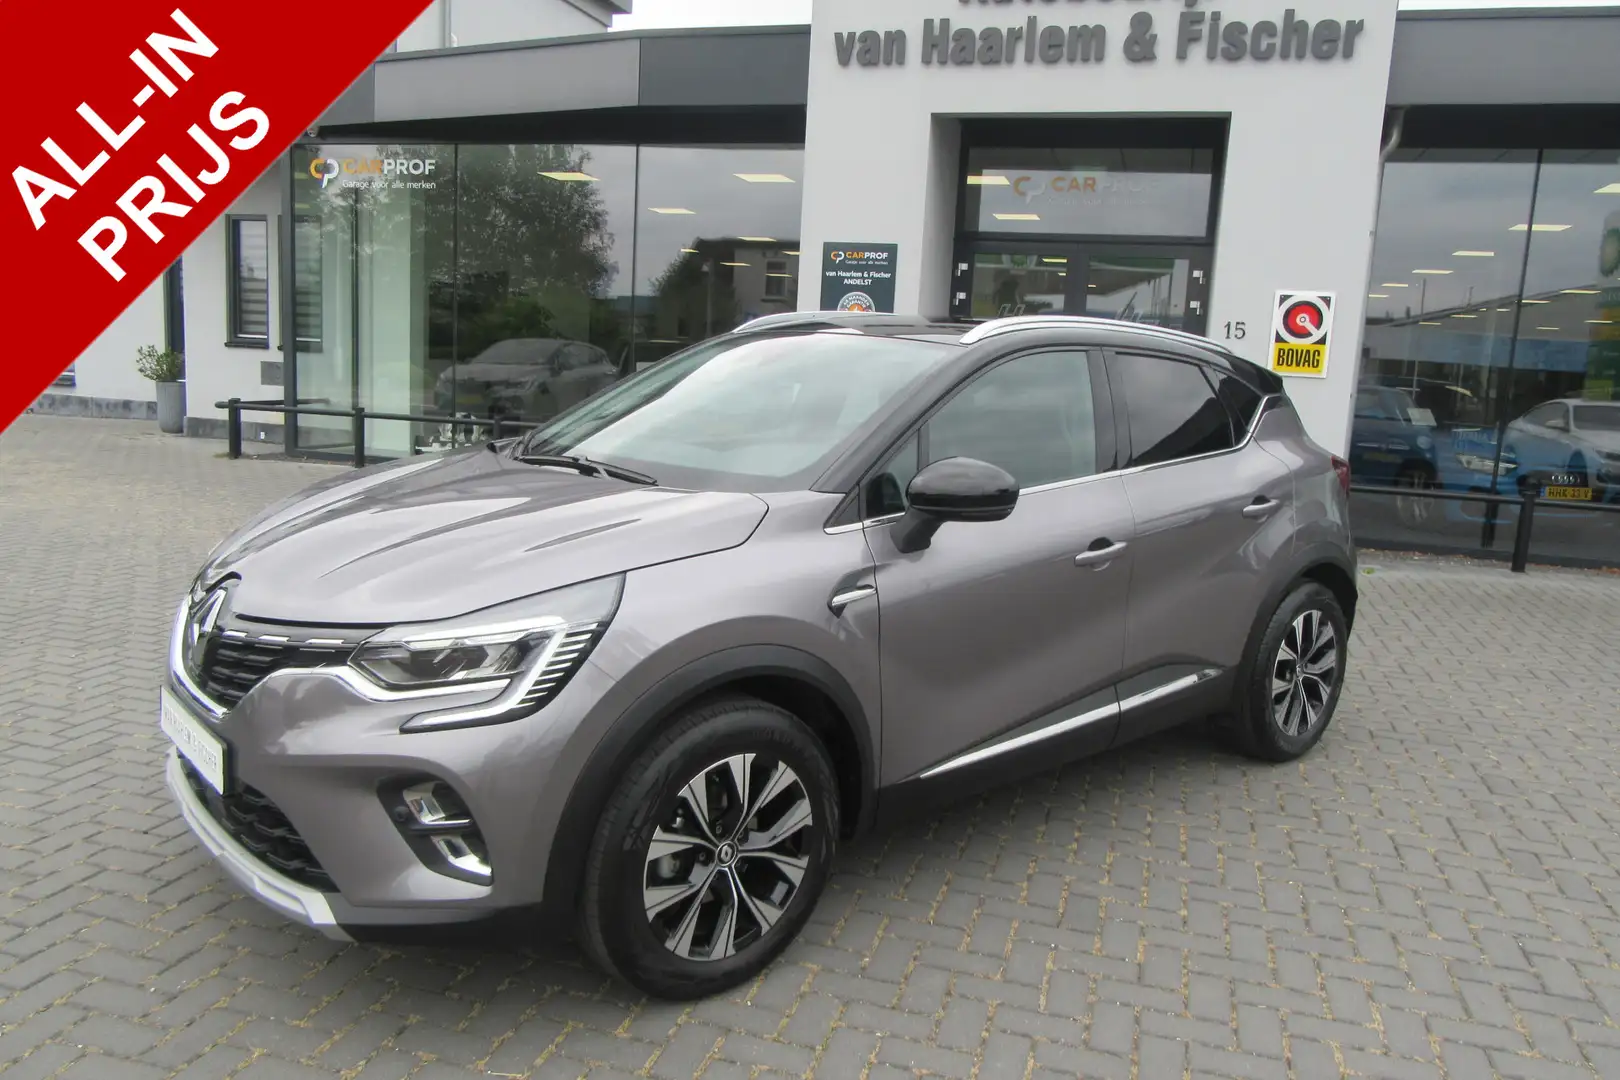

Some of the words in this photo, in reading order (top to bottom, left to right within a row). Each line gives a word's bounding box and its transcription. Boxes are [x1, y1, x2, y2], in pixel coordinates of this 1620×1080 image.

[834, 29, 907, 67] van
[921, 16, 1106, 65] Haarlem
[1123, 11, 1158, 62] &
[1176, 9, 1364, 60] Fischer
[343, 158, 436, 175] CARPROF
[342, 180, 369, 190] Garage
[391, 180, 404, 189] alle
[407, 180, 436, 189] merken
[846, 251, 888, 259] CARPROF
[1224, 321, 1246, 340] 15
[1276, 347, 1321, 369] BOVAG
